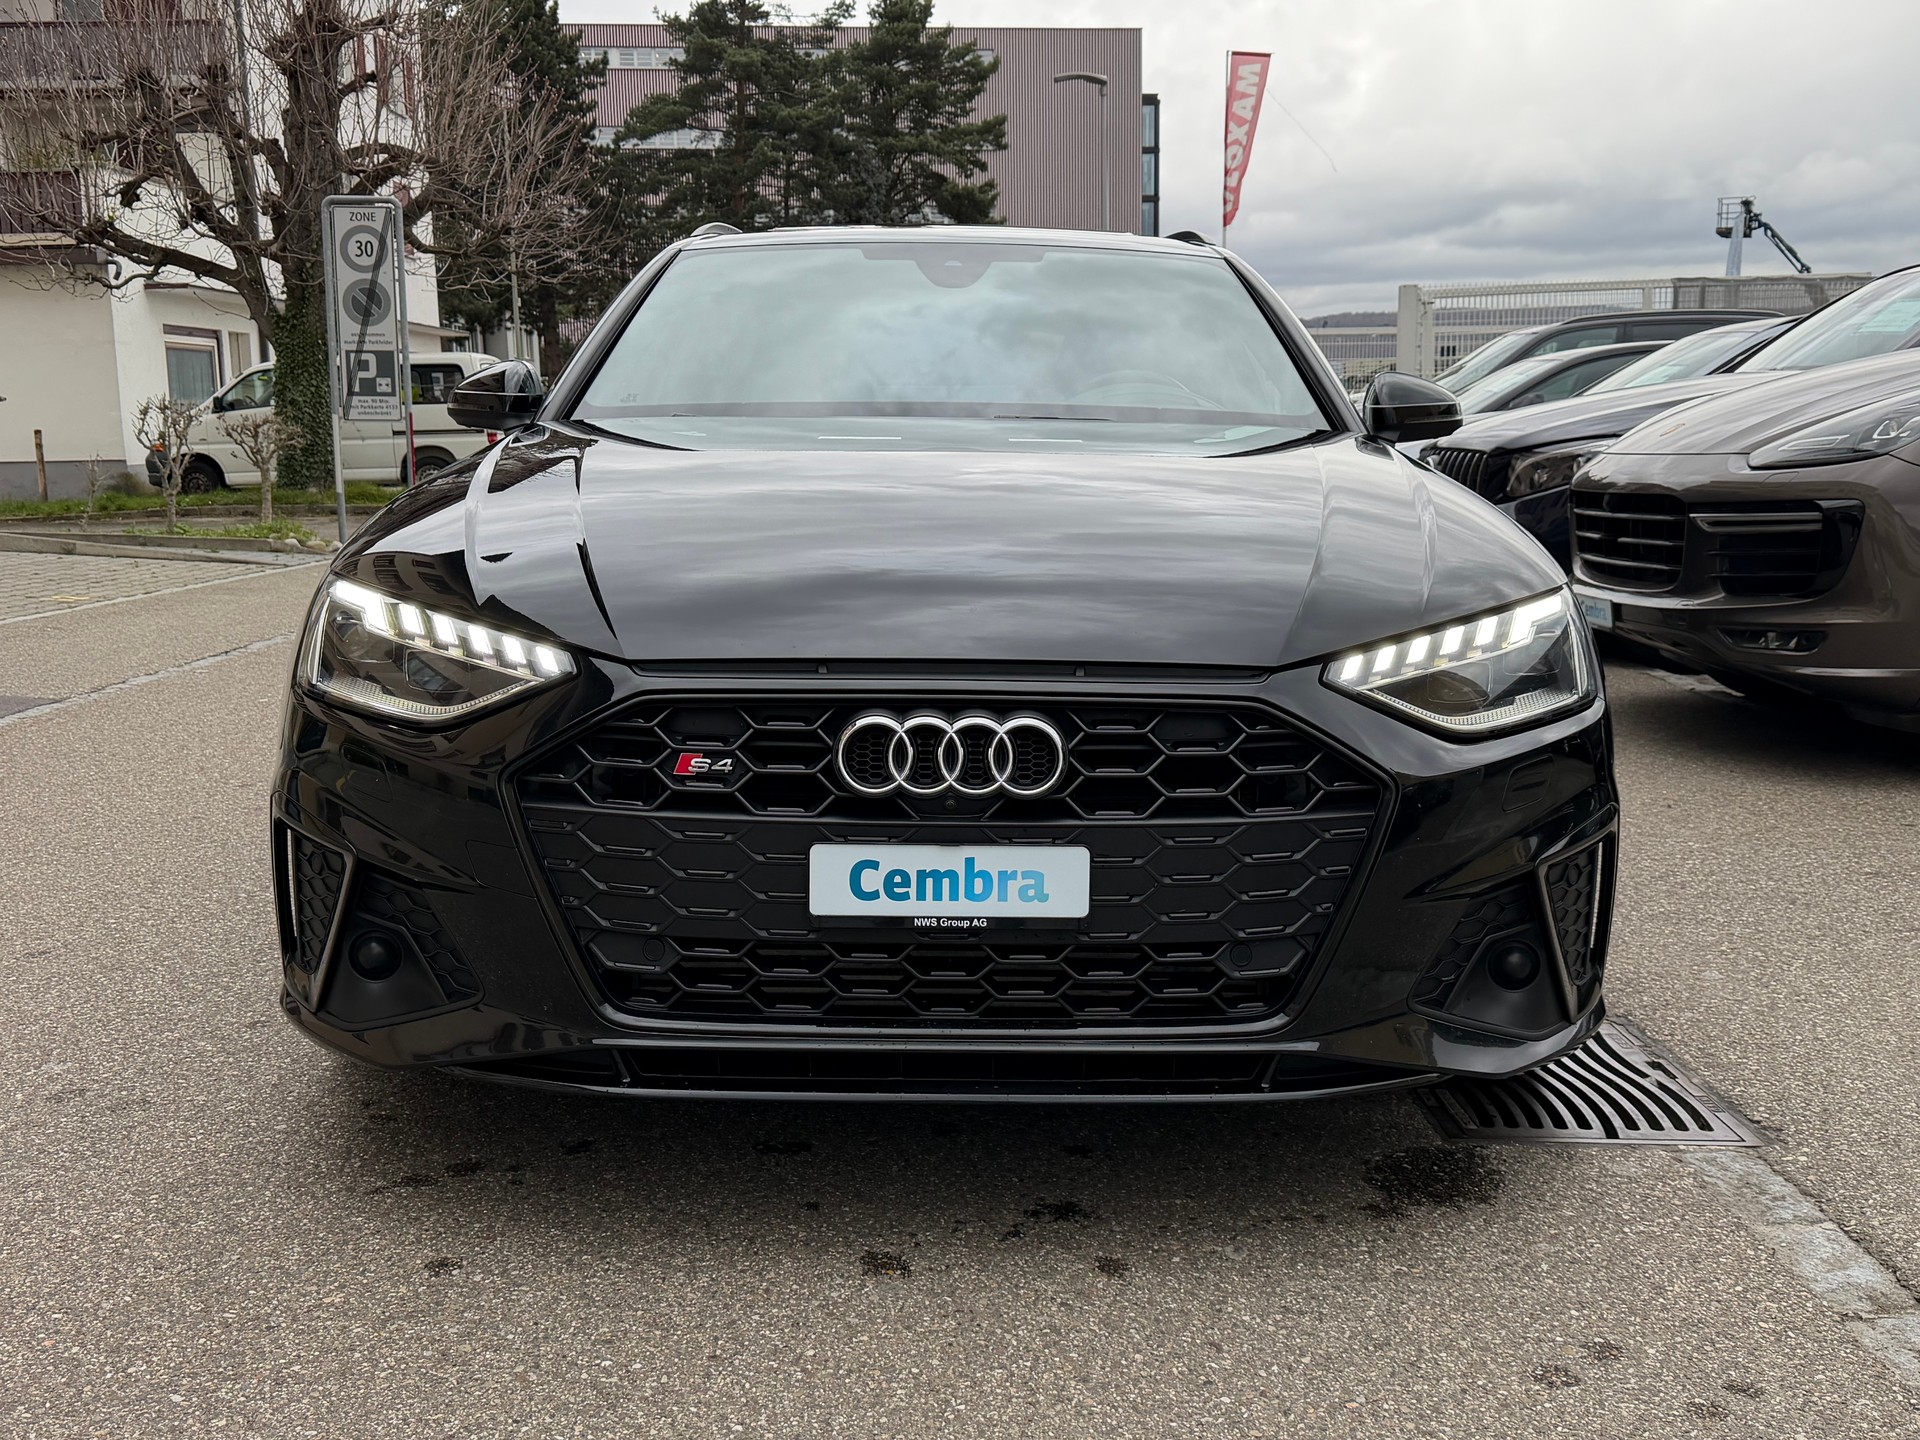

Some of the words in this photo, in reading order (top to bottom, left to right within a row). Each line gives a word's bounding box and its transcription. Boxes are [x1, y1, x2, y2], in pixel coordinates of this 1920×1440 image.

[349, 211, 377, 222] ZONE
[354, 240, 374, 257] 30
[687, 757, 733, 773] S4
[849, 856, 1050, 904] Cembra
[914, 918, 938, 927] NWS
[940, 918, 970, 929] Group
[971, 918, 987, 927] AG
